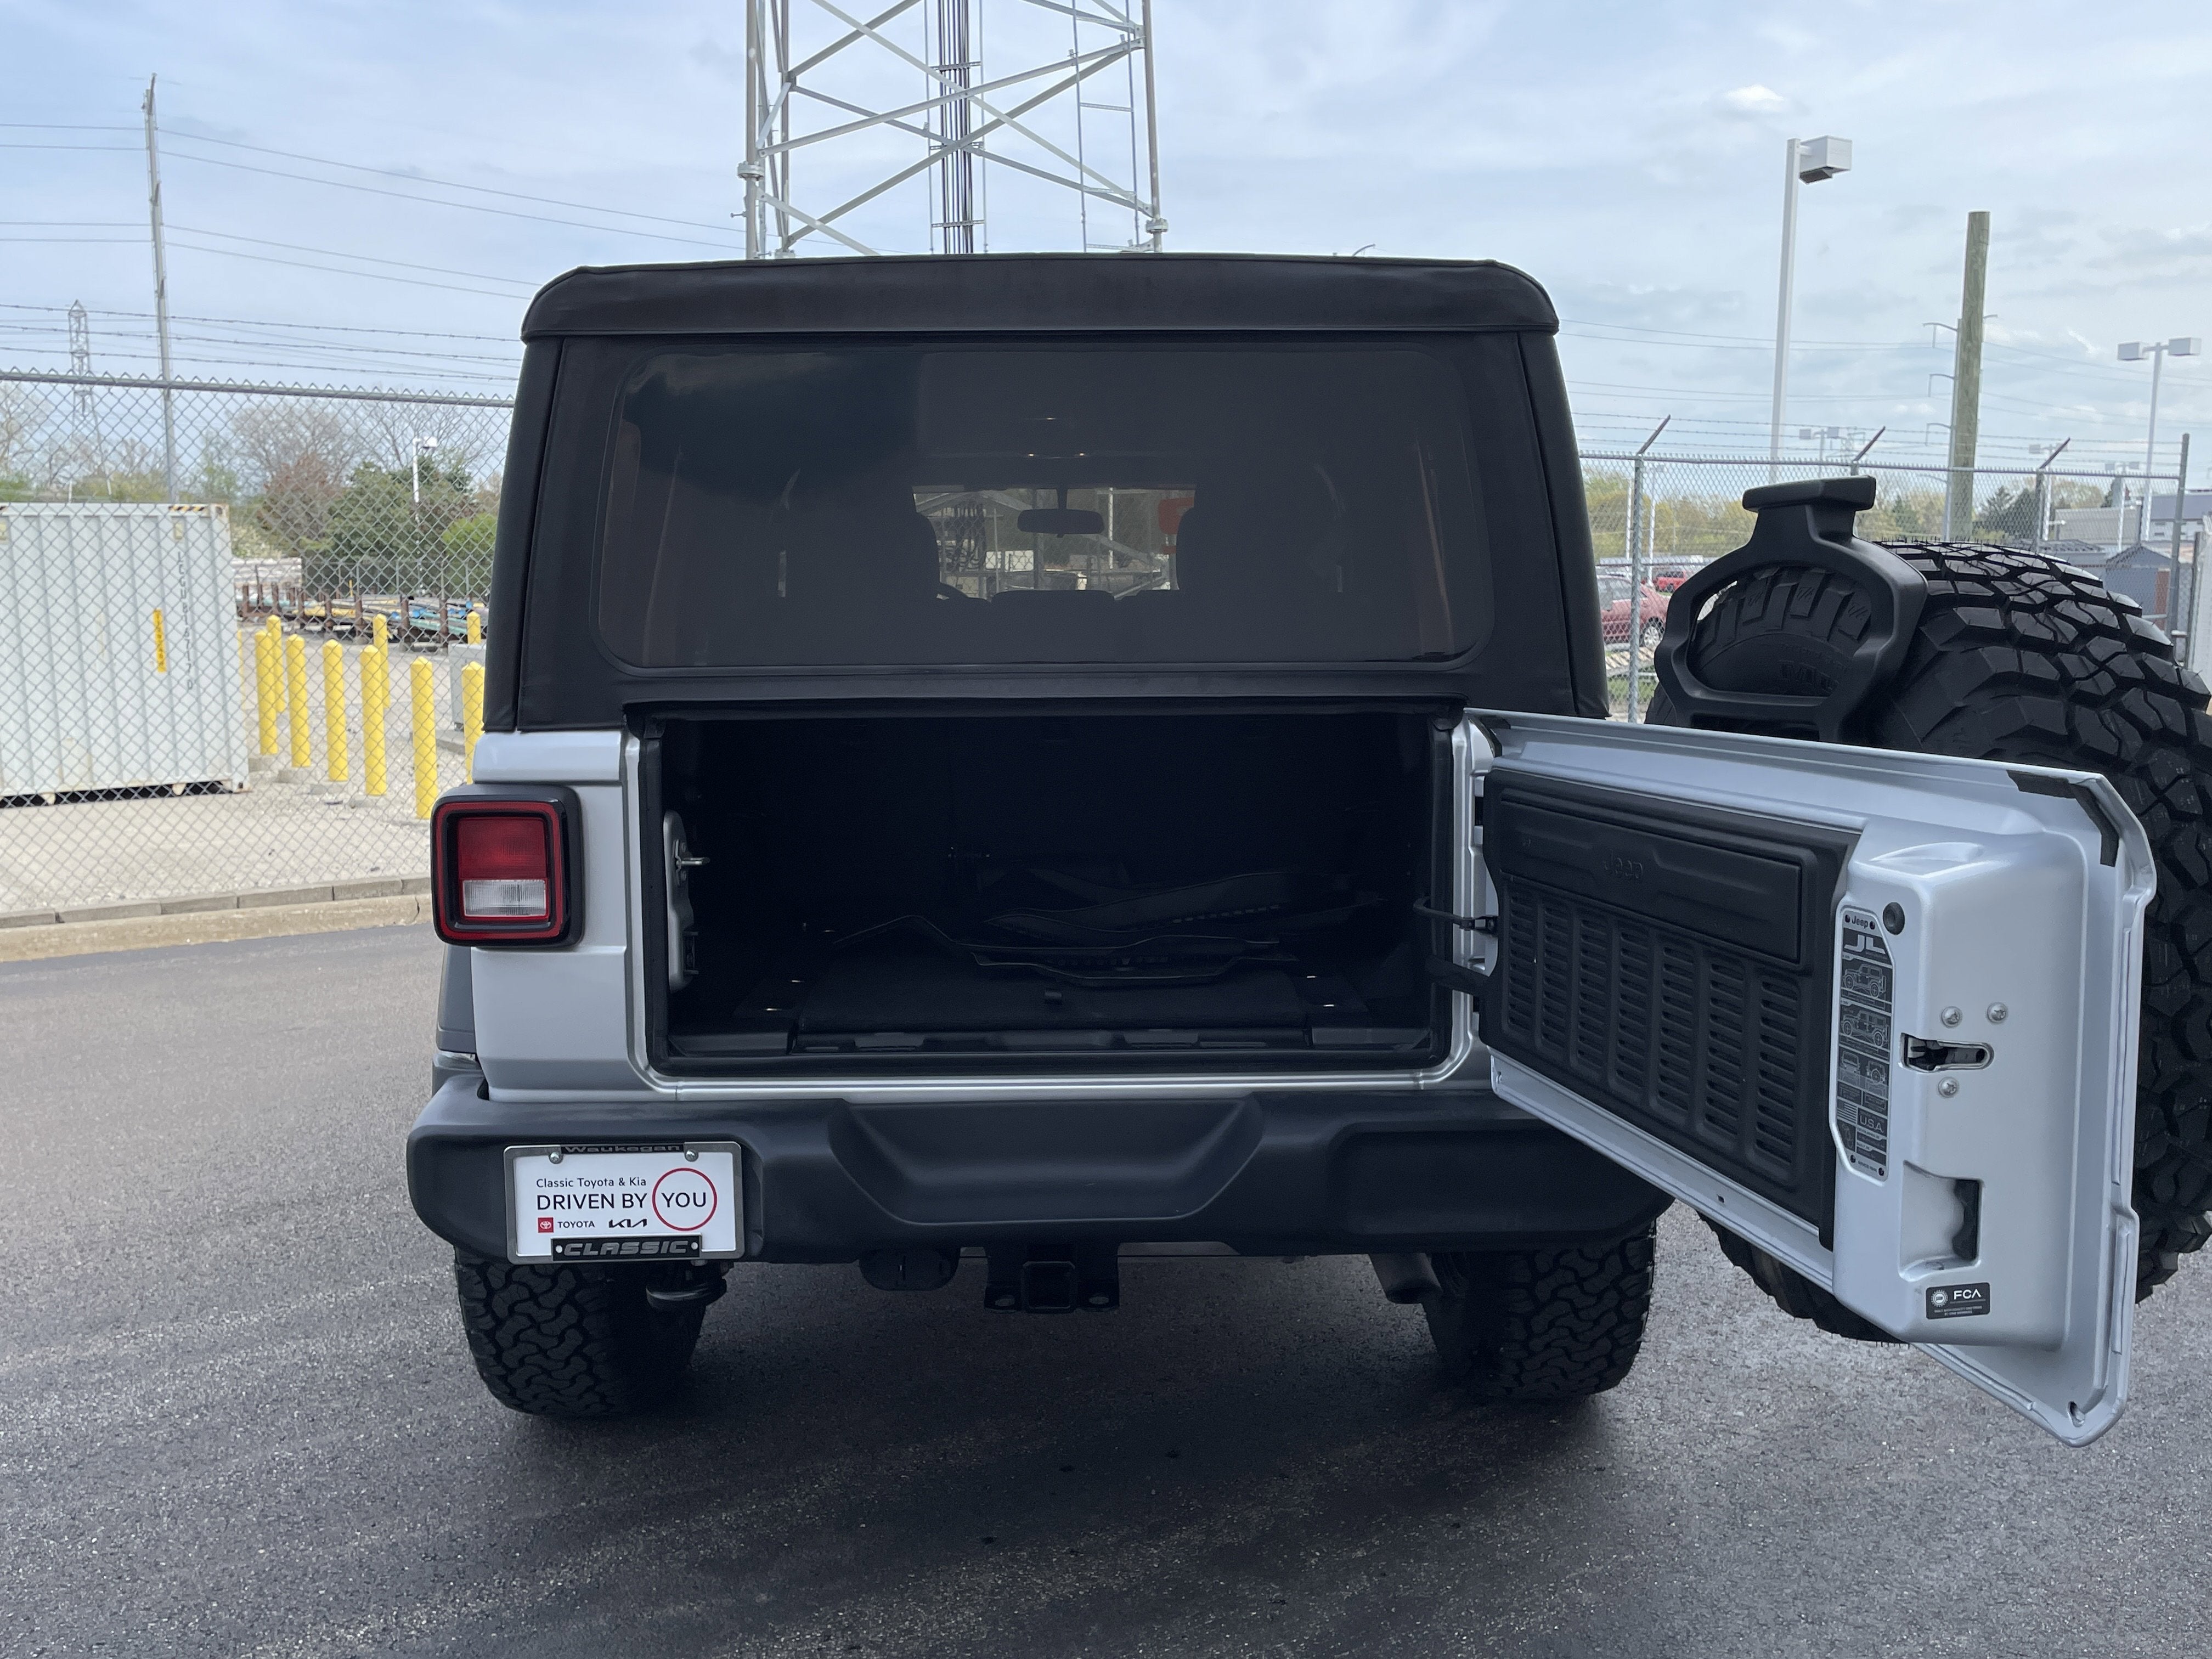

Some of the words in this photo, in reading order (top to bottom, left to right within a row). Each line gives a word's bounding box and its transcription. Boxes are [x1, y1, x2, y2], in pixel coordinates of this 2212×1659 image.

[1852, 915, 1869, 929] Jeep
[1844, 934, 1886, 955] JL
[536, 1177, 574, 1188] Classic
[578, 1177, 614, 1189] Toyota
[618, 1177, 625, 1187] &
[629, 1176, 646, 1187] Kia
[537, 1193, 614, 1210] DRIVEN
[622, 1193, 647, 1209] BY
[661, 1192, 707, 1208] YOU
[564, 1240, 689, 1256] CLASSIC
[1954, 1288, 1982, 1300] FCA
